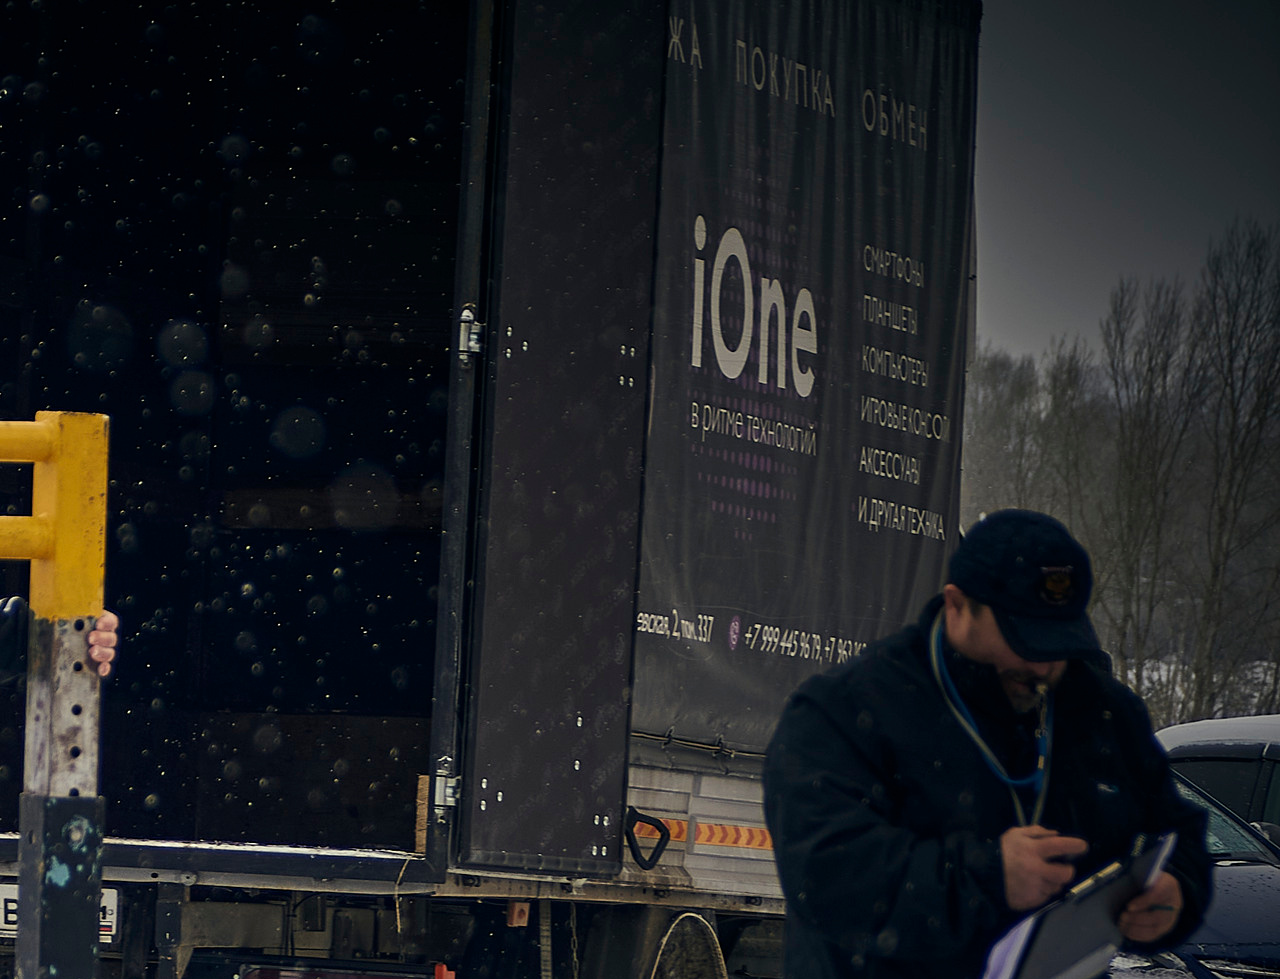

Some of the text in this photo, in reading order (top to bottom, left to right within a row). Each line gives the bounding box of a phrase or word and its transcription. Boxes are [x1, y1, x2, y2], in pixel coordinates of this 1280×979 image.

[736, 39, 835, 118] ПОКУПКА
[862, 89, 928, 151] ОБМЕН
[863, 244, 924, 288] СМАРТФОНЫ
[691, 214, 818, 398] iOne
[863, 294, 918, 335] ПЛАНШЕТЫ
[861, 344, 929, 387] КОМПЬЮТЕРЫ
[701, 404, 745, 442] ритме
[746, 414, 817, 457] технологий
[861, 395, 907, 432] ИГРОВЫЕ
[859, 446, 920, 485] АКСЕССУАРЫ
[858, 496, 946, 541] И ДРУГАЯ ТЕХНИКА
[697, 613, 715, 643] 337
[760, 625, 781, 653] 999
[780, 628, 799, 657] 445
